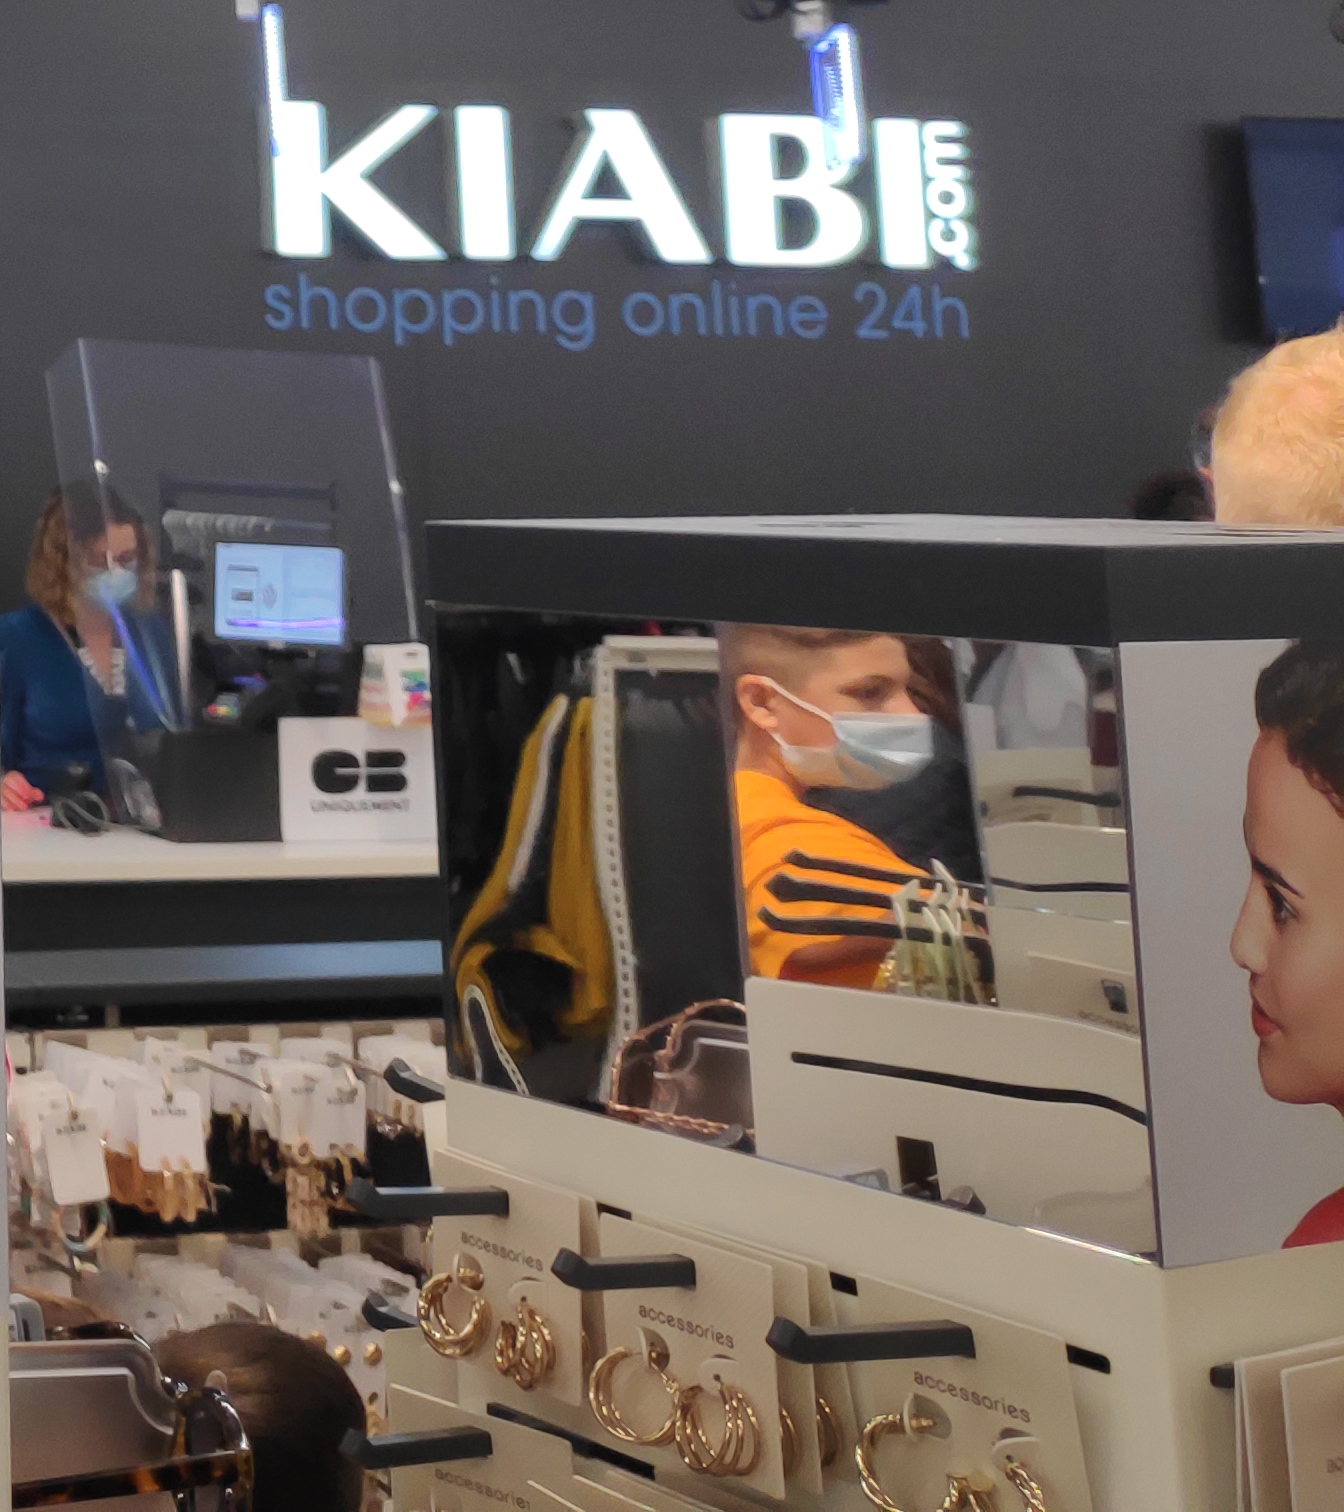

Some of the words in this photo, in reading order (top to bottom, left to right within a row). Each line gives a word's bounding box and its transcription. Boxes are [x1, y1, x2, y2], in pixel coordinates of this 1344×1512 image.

[272, 99, 930, 270] KIABI
[920, 118, 978, 272] .com
[264, 273, 595, 350] shopping
[622, 282, 828, 338] online
[855, 281, 970, 340] 24h
[461, 1231, 544, 1272] accessories
[638, 1304, 735, 1349] accessories
[913, 1371, 1031, 1423] accessories
[434, 1468, 530, 1510] accessorie
